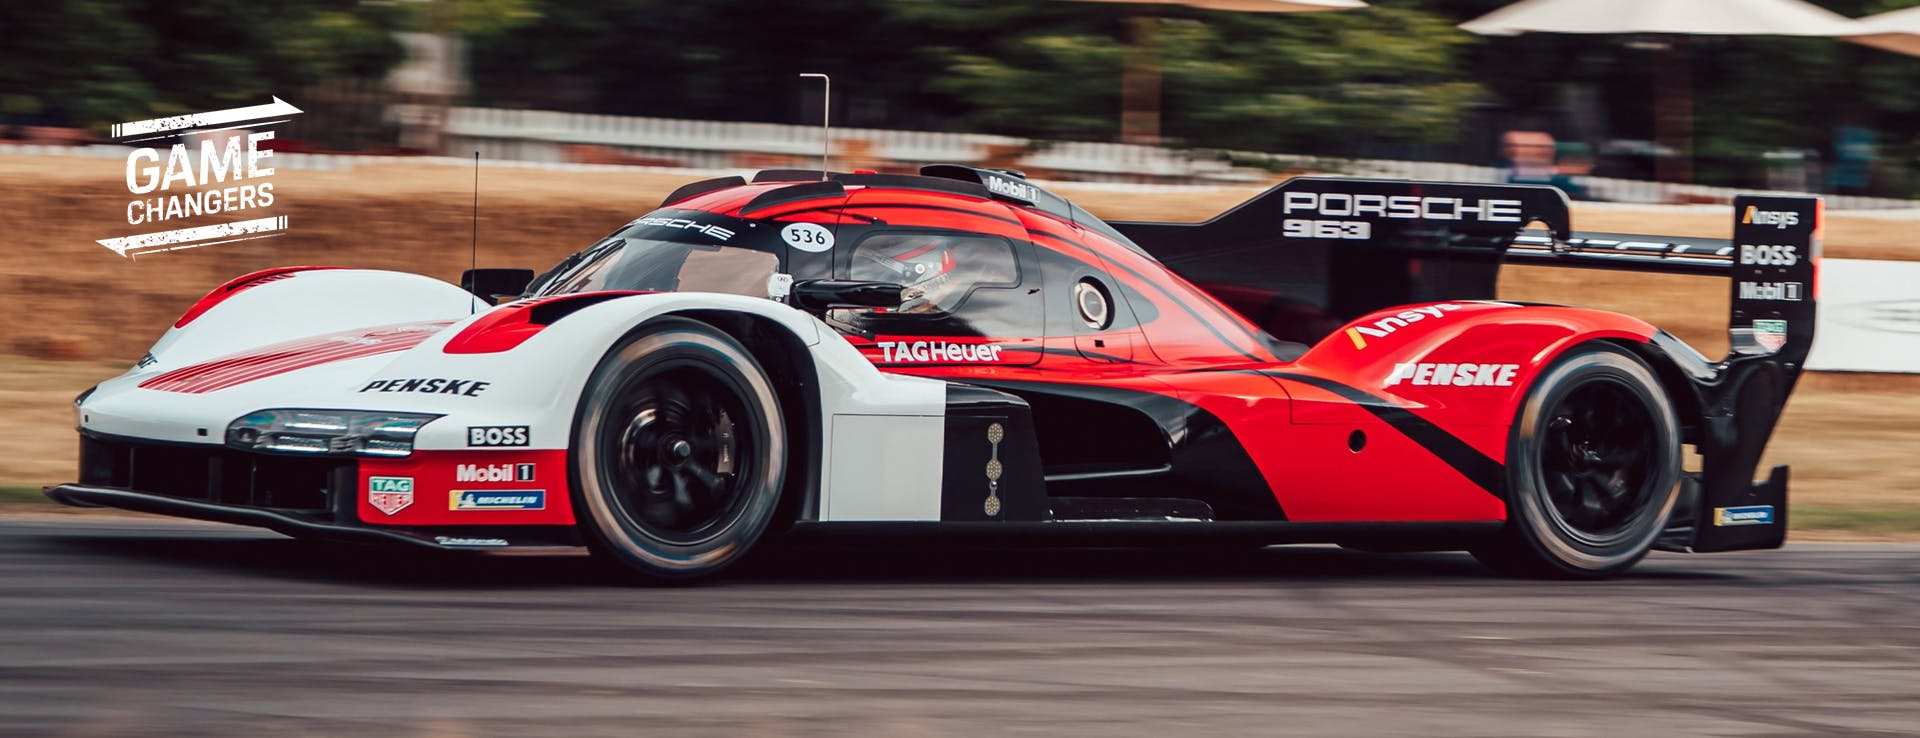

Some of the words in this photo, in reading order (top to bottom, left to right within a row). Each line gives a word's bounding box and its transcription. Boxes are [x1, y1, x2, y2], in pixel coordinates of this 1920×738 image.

[989, 175, 1026, 199] Mobil
[1283, 191, 1522, 222] PORSCHE
[790, 228, 826, 246] 536
[1282, 219, 1372, 240] 963
[1740, 244, 1798, 266] BOSS
[1739, 281, 1785, 300] Mobil
[1345, 302, 1463, 350] Ansys
[1384, 362, 1520, 387] PENSKE
[358, 378, 491, 397] PENSKE
[470, 427, 528, 446] BOSS
[456, 463, 514, 483] Mobil
[372, 479, 410, 492] TAG
